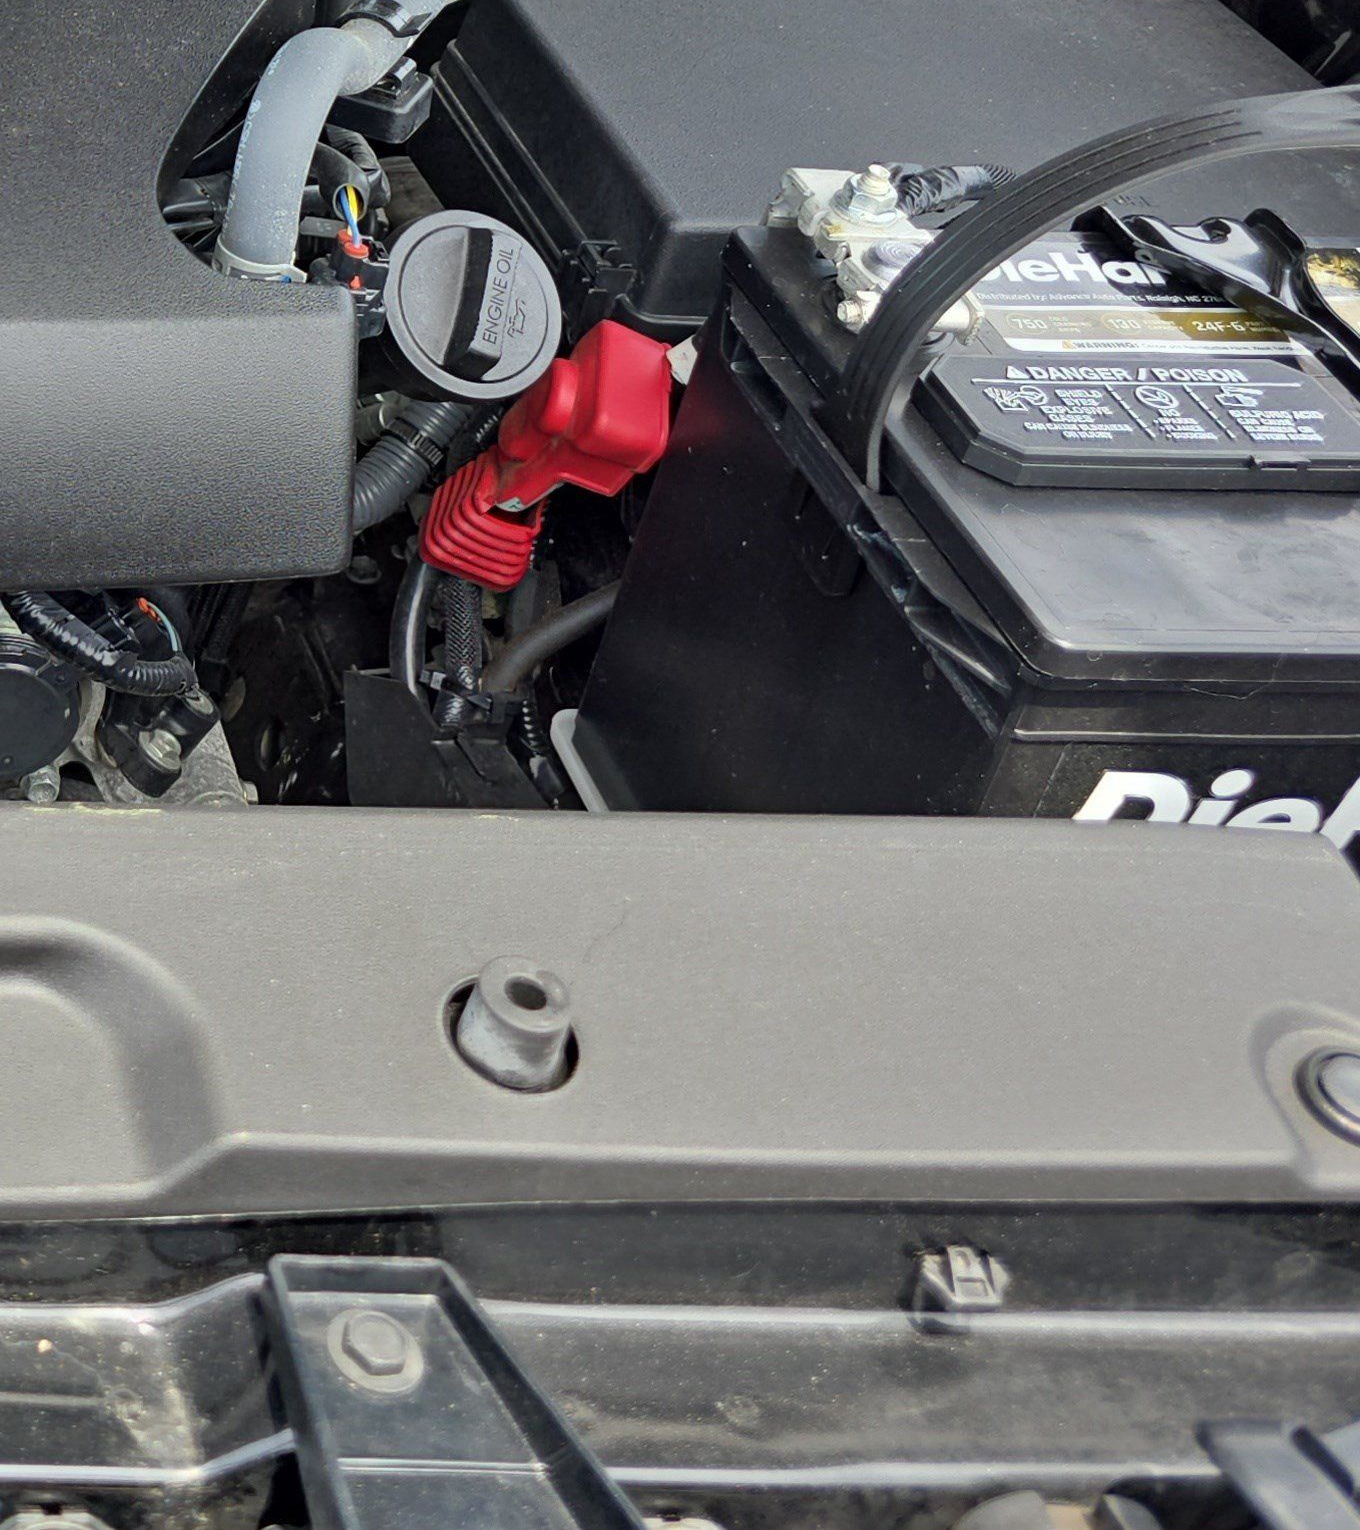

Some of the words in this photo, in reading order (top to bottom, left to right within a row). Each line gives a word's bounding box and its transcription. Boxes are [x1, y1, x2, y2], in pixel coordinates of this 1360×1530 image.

[482, 276, 509, 346] ENGINE
[497, 247, 515, 274] OIL
[1011, 318, 1048, 330] 750
[1107, 318, 1142, 330] 130
[1192, 320, 1245, 332] 24F-6
[1072, 341, 1139, 350] WARNING:
[1026, 366, 1132, 381] DANGER
[1151, 368, 1248, 383] POISON
[1055, 389, 1103, 398] SHIELD
[1040, 405, 1113, 415] EXPLOSIVE
[1158, 409, 1181, 417] NO
[1292, 410, 1326, 419] ACID
[1048, 414, 1096, 423] GASES
[1072, 768, 1360, 851] Die
